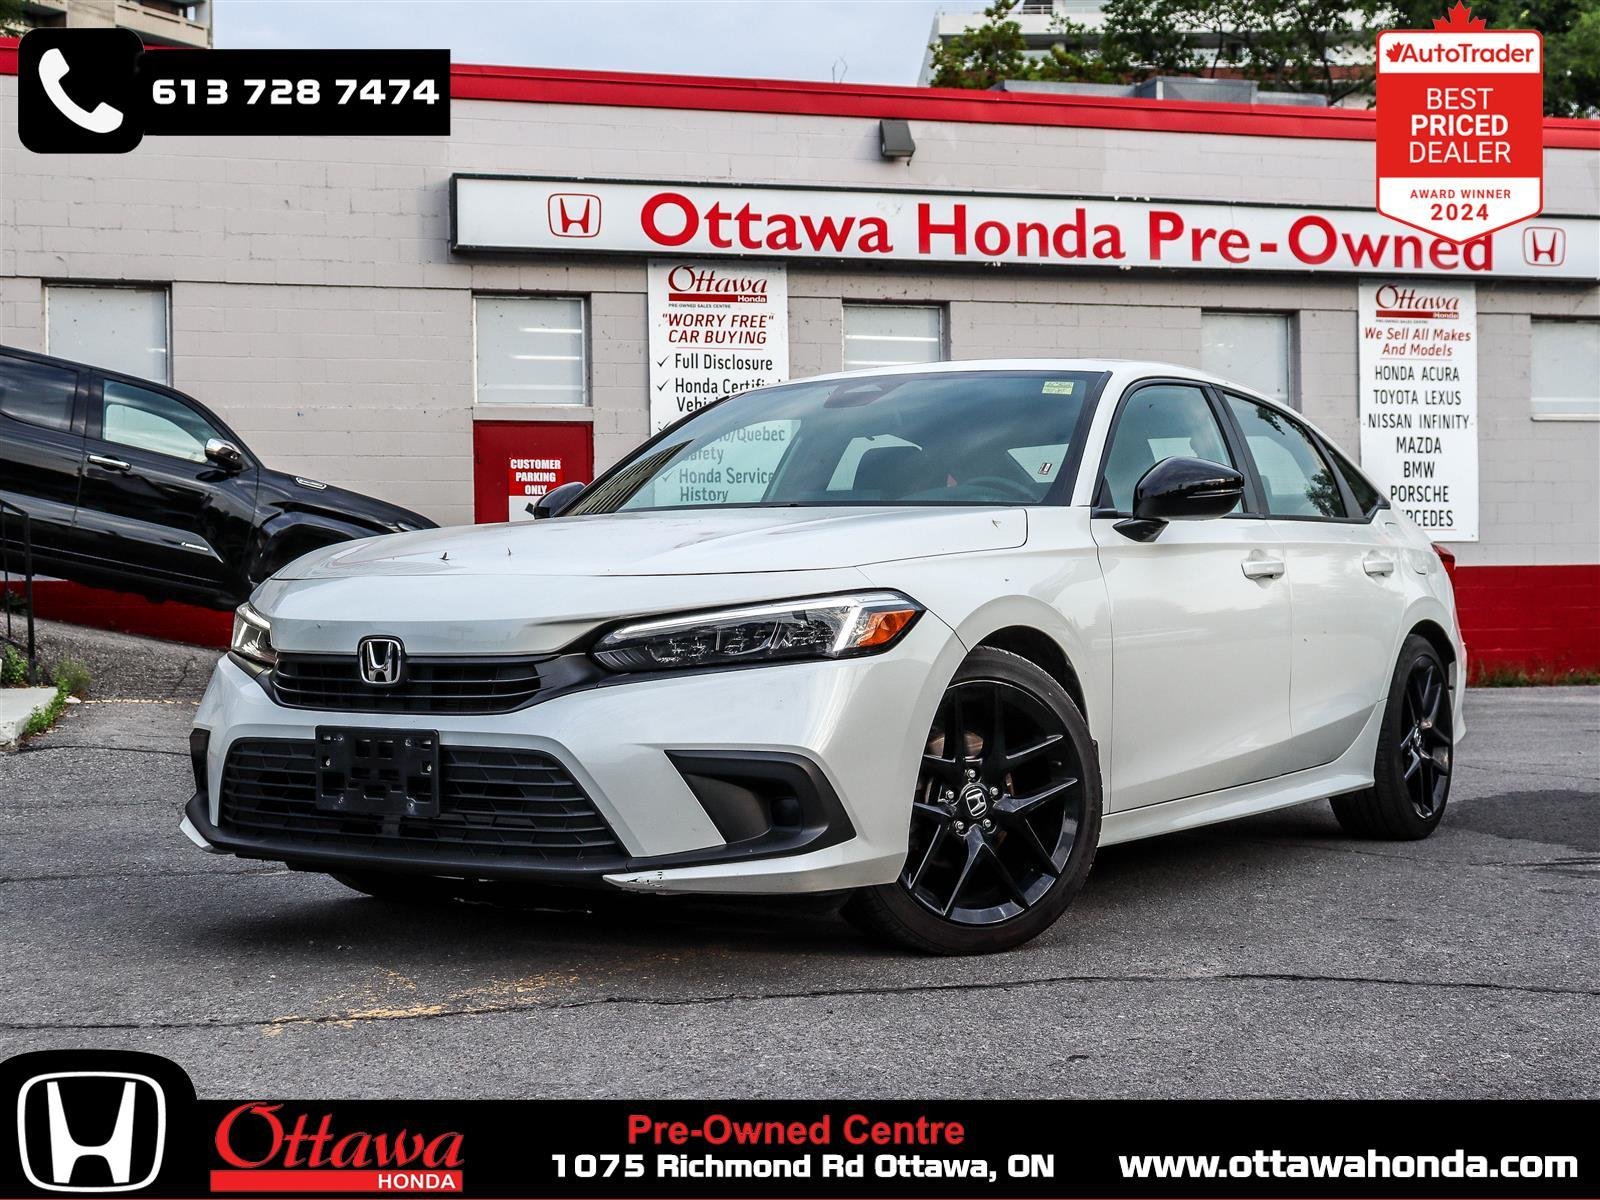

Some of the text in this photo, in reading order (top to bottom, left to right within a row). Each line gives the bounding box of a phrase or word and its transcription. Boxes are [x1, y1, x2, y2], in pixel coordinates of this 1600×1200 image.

[640, 192, 894, 253] Ottawa
[917, 202, 1126, 260] Honda
[667, 263, 768, 293] Ottawa
[737, 295, 766, 303] Honda
[1375, 283, 1460, 310] Ottawa
[668, 329, 767, 345] CAR BUYING
[1364, 327, 1472, 342] We Sell All Makes
[1382, 343, 1453, 357] And Models
[675, 352, 773, 371] Full Disclosure
[1375, 365, 1460, 382] HONDA ACURA
[675, 377, 718, 394] Honda
[1373, 389, 1462, 405] TOYOTA LEXUS
[1368, 413, 1470, 429] NISSAN INFINITY
[1396, 436, 1443, 454] MAZDA
[510, 459, 561, 470] CUSTOMER
[1403, 461, 1435, 478] BMW
[515, 471, 556, 482] PARKING
[679, 468, 722, 484] Honda
[524, 485, 547, 495] ONLY
[680, 486, 729, 503] History
[1390, 485, 1449, 503] PORSCHE
